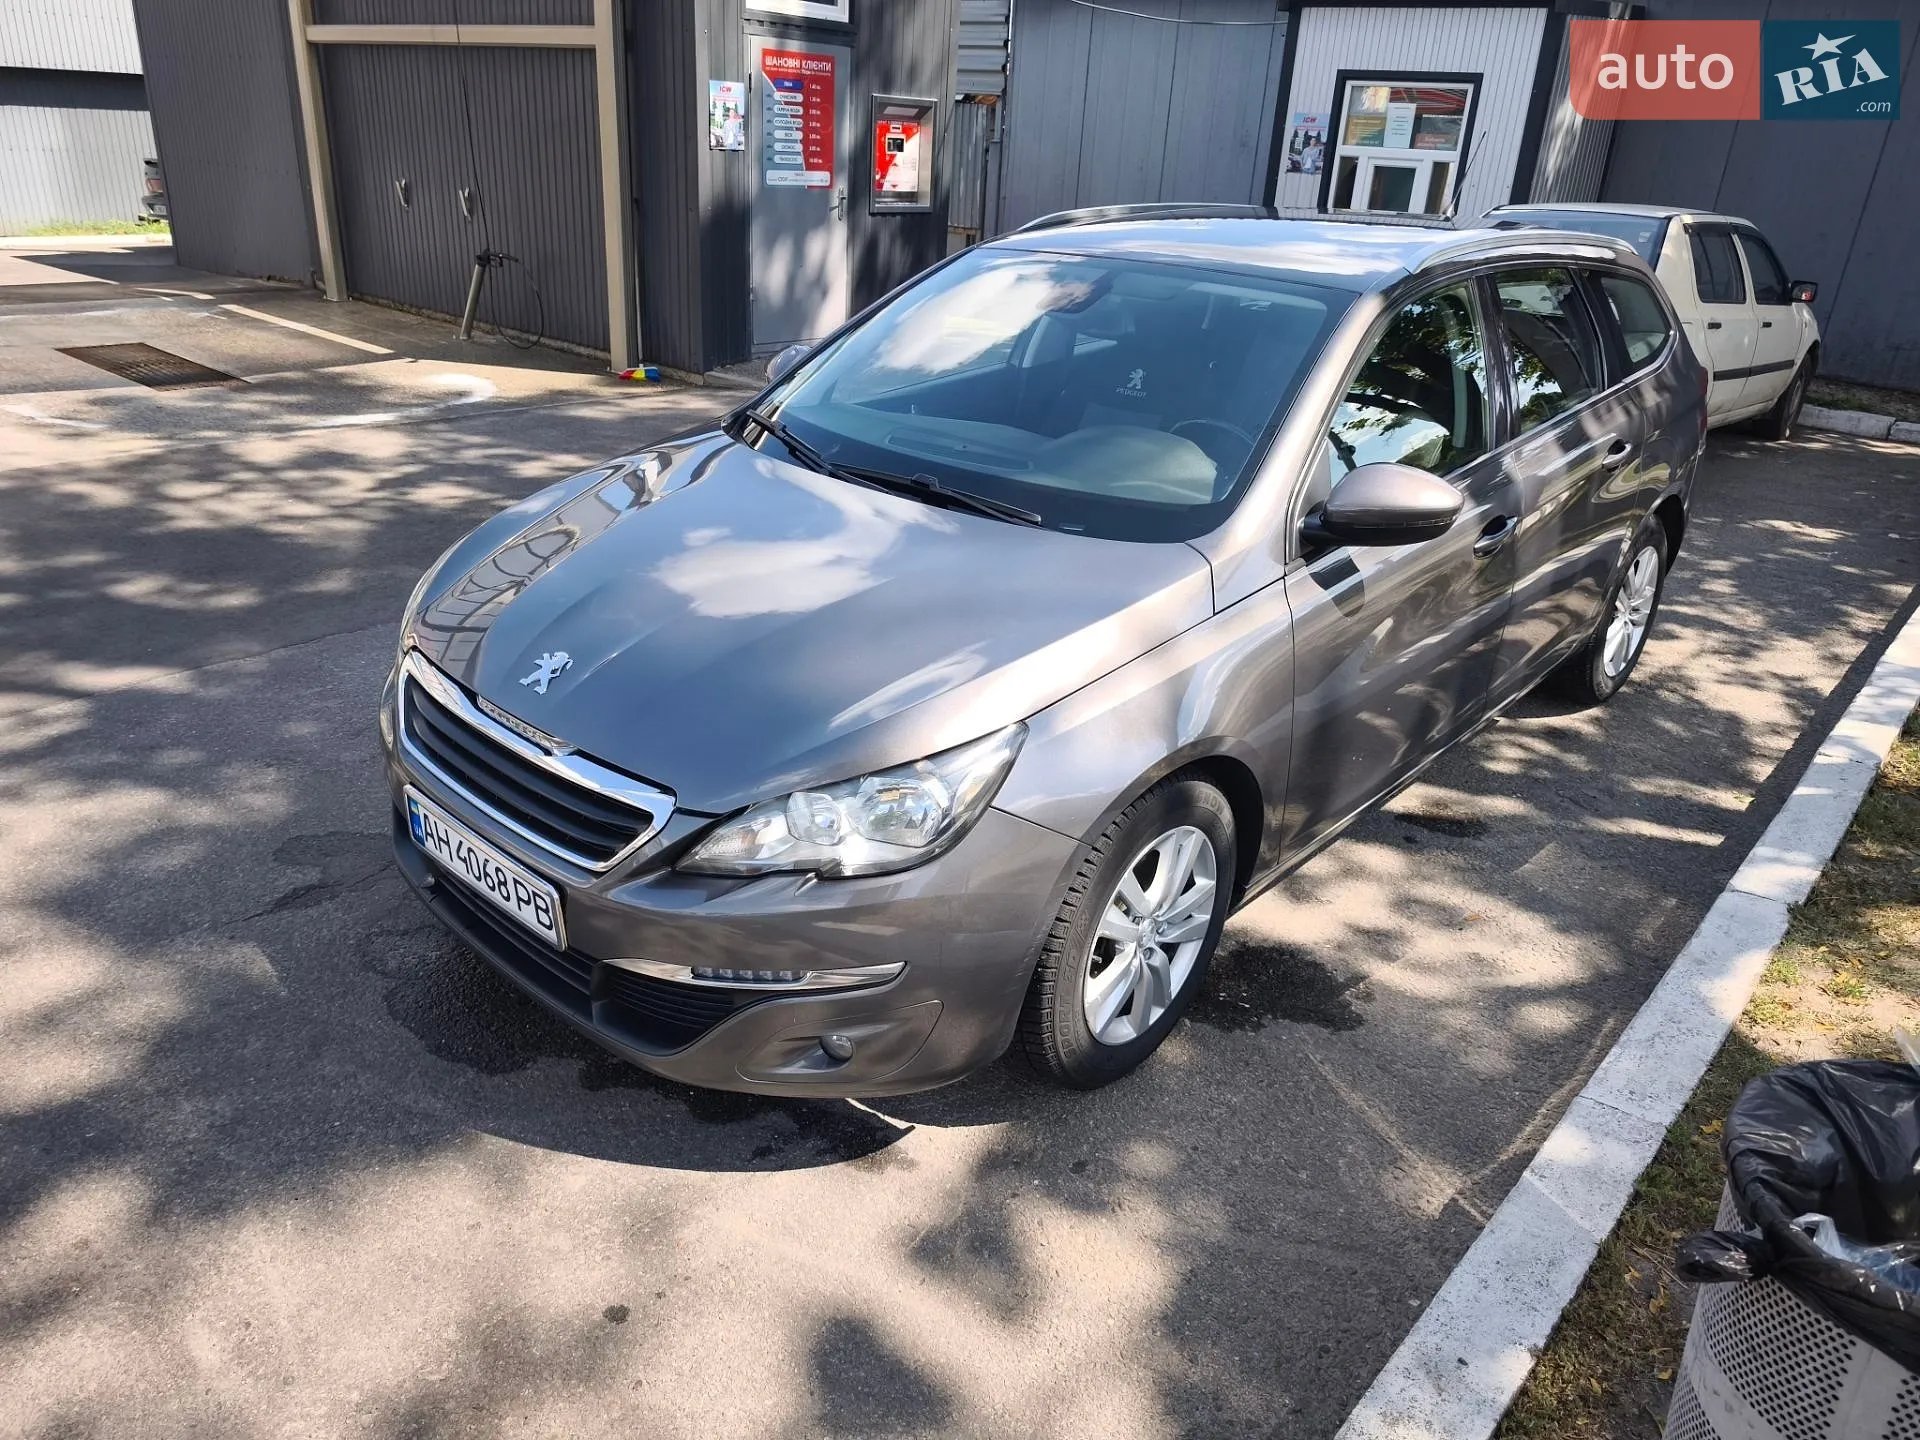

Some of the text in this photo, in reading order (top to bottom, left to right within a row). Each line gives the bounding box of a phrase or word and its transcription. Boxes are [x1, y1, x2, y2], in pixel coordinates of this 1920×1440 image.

[765, 55, 800, 68] ШАНОВНІ
[801, 60, 832, 72] КЛІЄНТИ
[423, 812, 553, 931] AH 4068 PB
